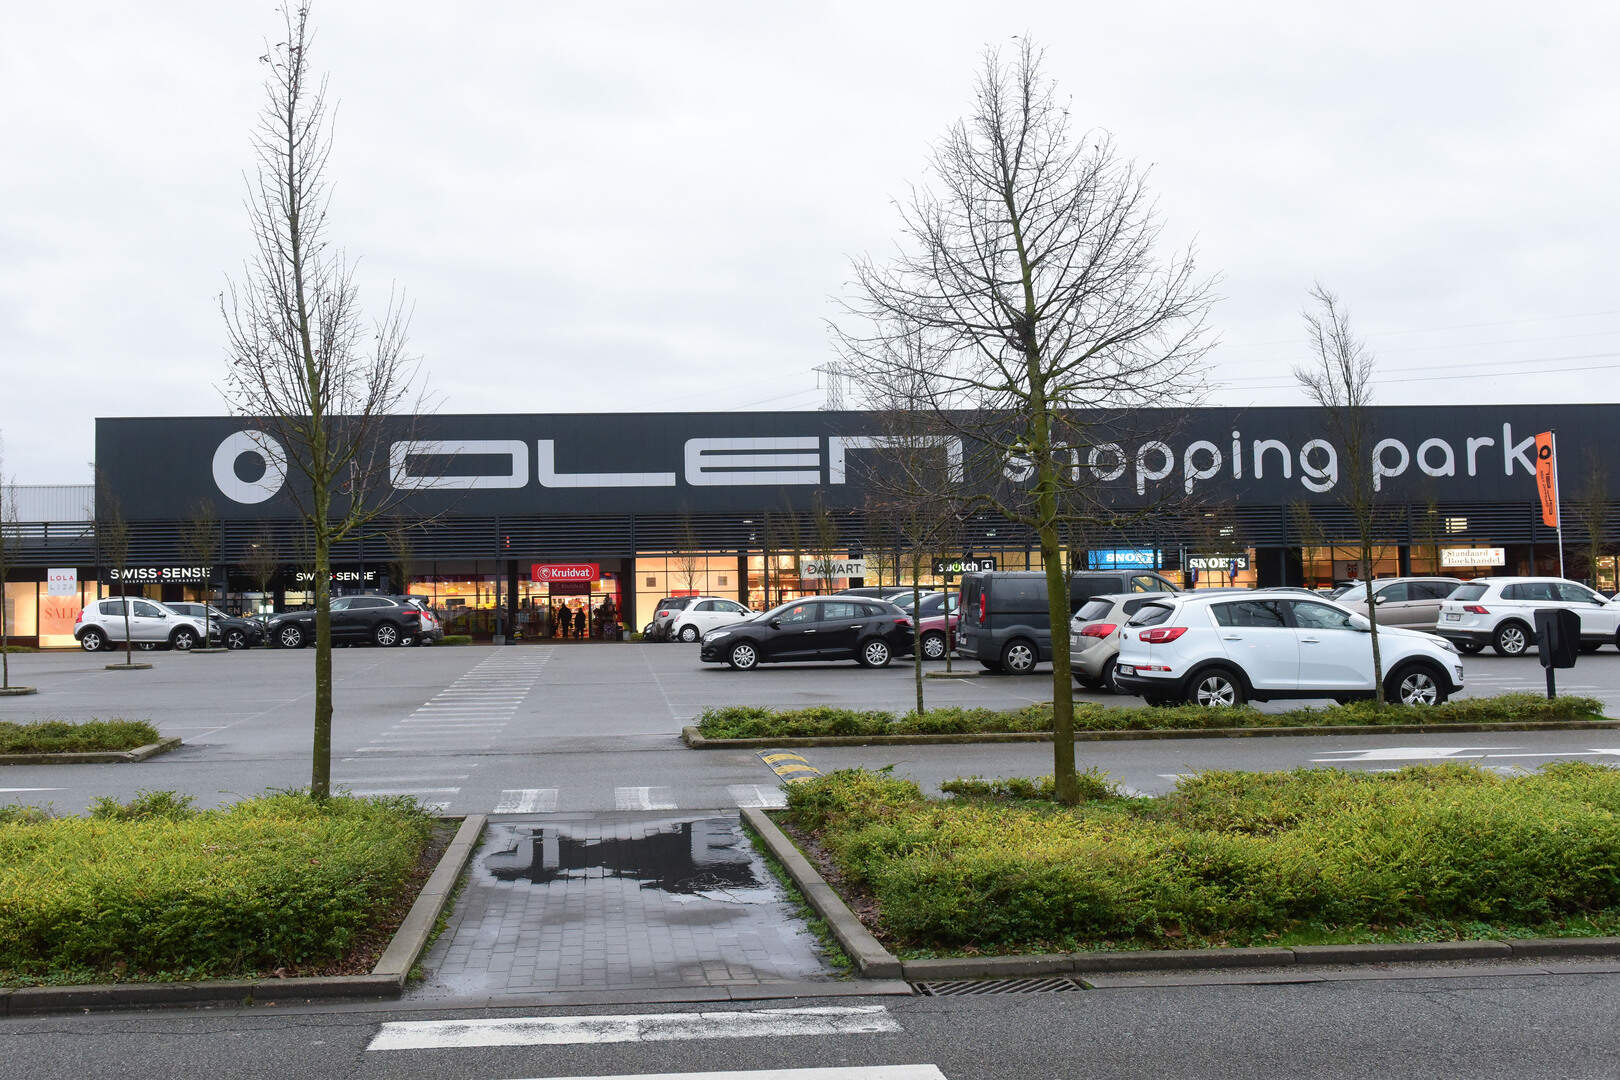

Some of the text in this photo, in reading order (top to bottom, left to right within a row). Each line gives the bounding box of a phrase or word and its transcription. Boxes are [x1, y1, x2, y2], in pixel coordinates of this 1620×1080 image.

[1372, 422, 1536, 492] park
[1189, 557, 1246, 569] SNOES
[295, 572, 333, 582] SWS
[551, 568, 590, 577] Kruidvat
